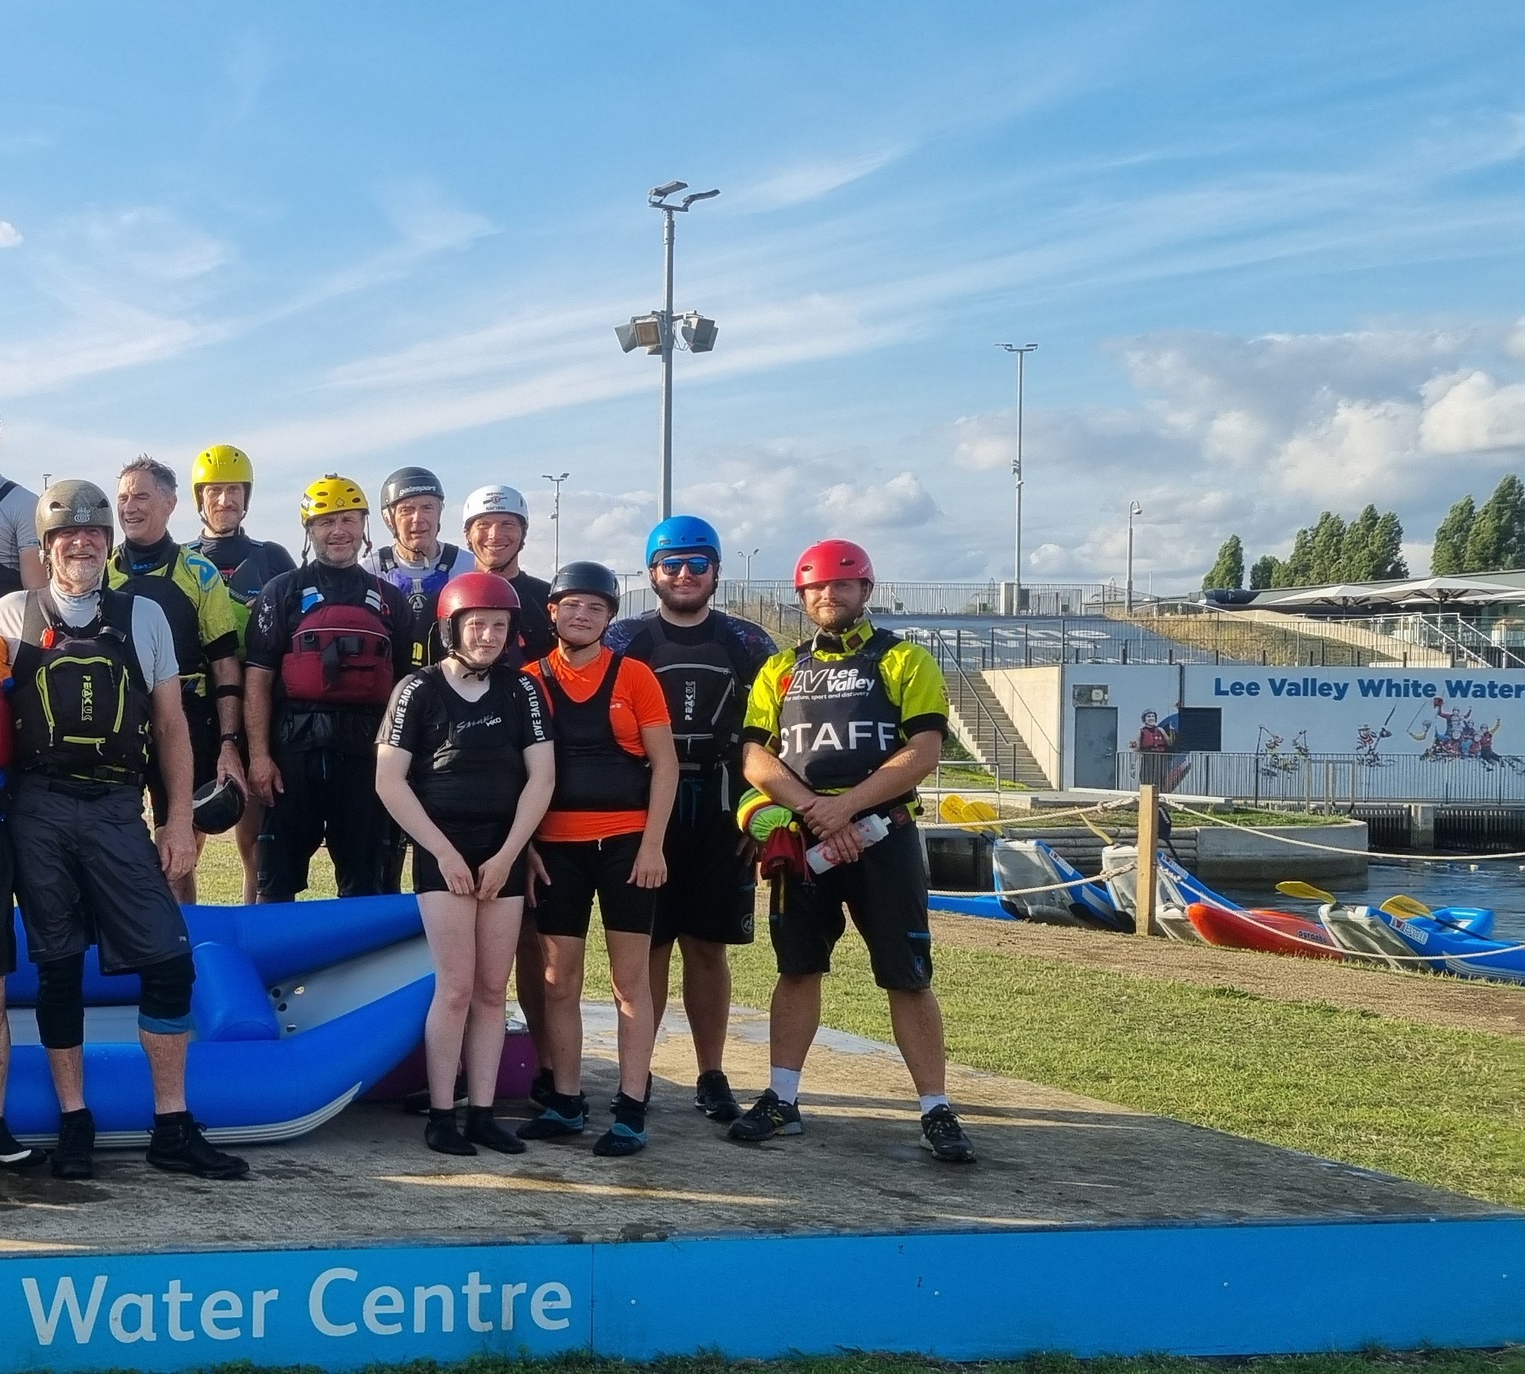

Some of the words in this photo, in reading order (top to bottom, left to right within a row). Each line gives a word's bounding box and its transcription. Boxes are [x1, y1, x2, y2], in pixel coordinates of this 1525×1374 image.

[827, 668, 859, 680] Lee
[827, 677, 875, 692] Valley
[1214, 678, 1261, 697] Lee
[1268, 677, 1350, 701] Valley
[1357, 678, 1437, 698] White
[1444, 679, 1525, 699] Water
[778, 721, 896, 759] STAFF
[21, 1274, 280, 1346] Water
[307, 1267, 572, 1337] Centre
